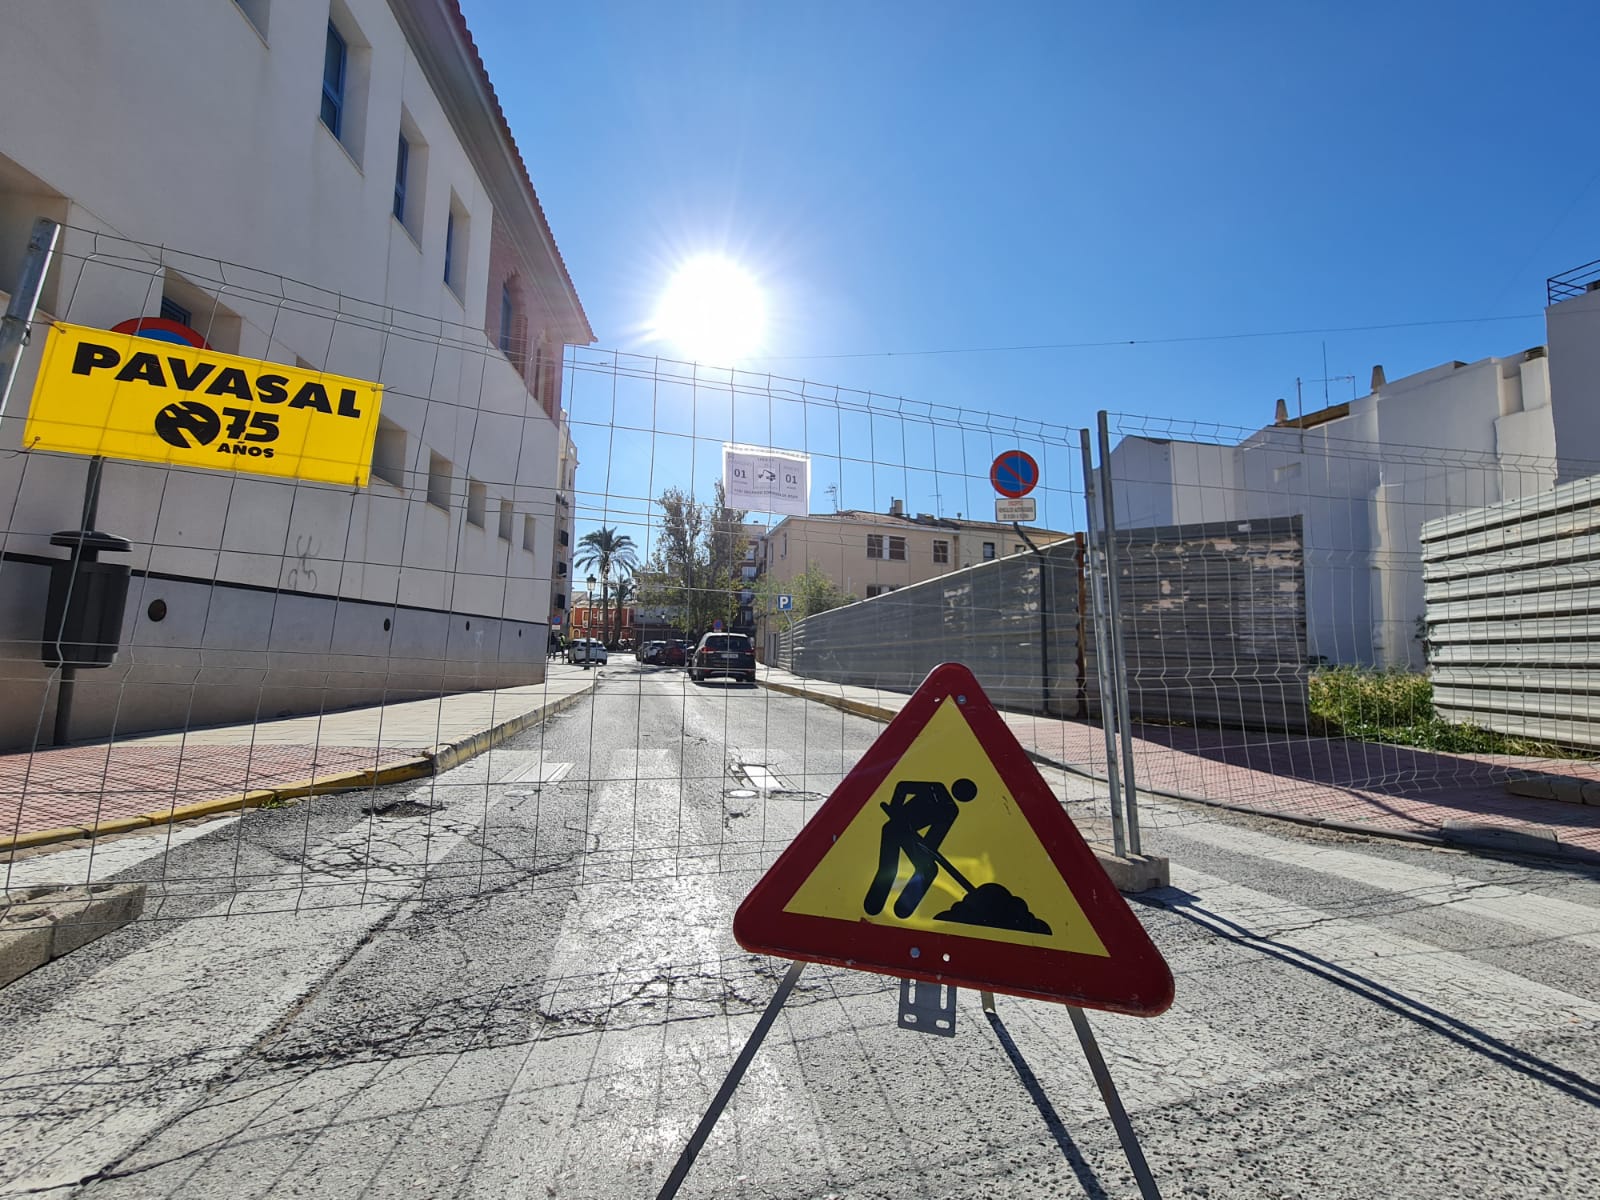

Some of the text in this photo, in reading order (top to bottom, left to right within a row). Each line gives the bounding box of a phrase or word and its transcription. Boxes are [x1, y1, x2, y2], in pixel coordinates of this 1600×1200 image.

[72, 342, 361, 418] PAVASAL
[222, 407, 279, 443] 75
[217, 440, 274, 458] AÑOS
[734, 468, 747, 478] 01
[785, 473, 798, 484] 01
[779, 596, 789, 609] P
